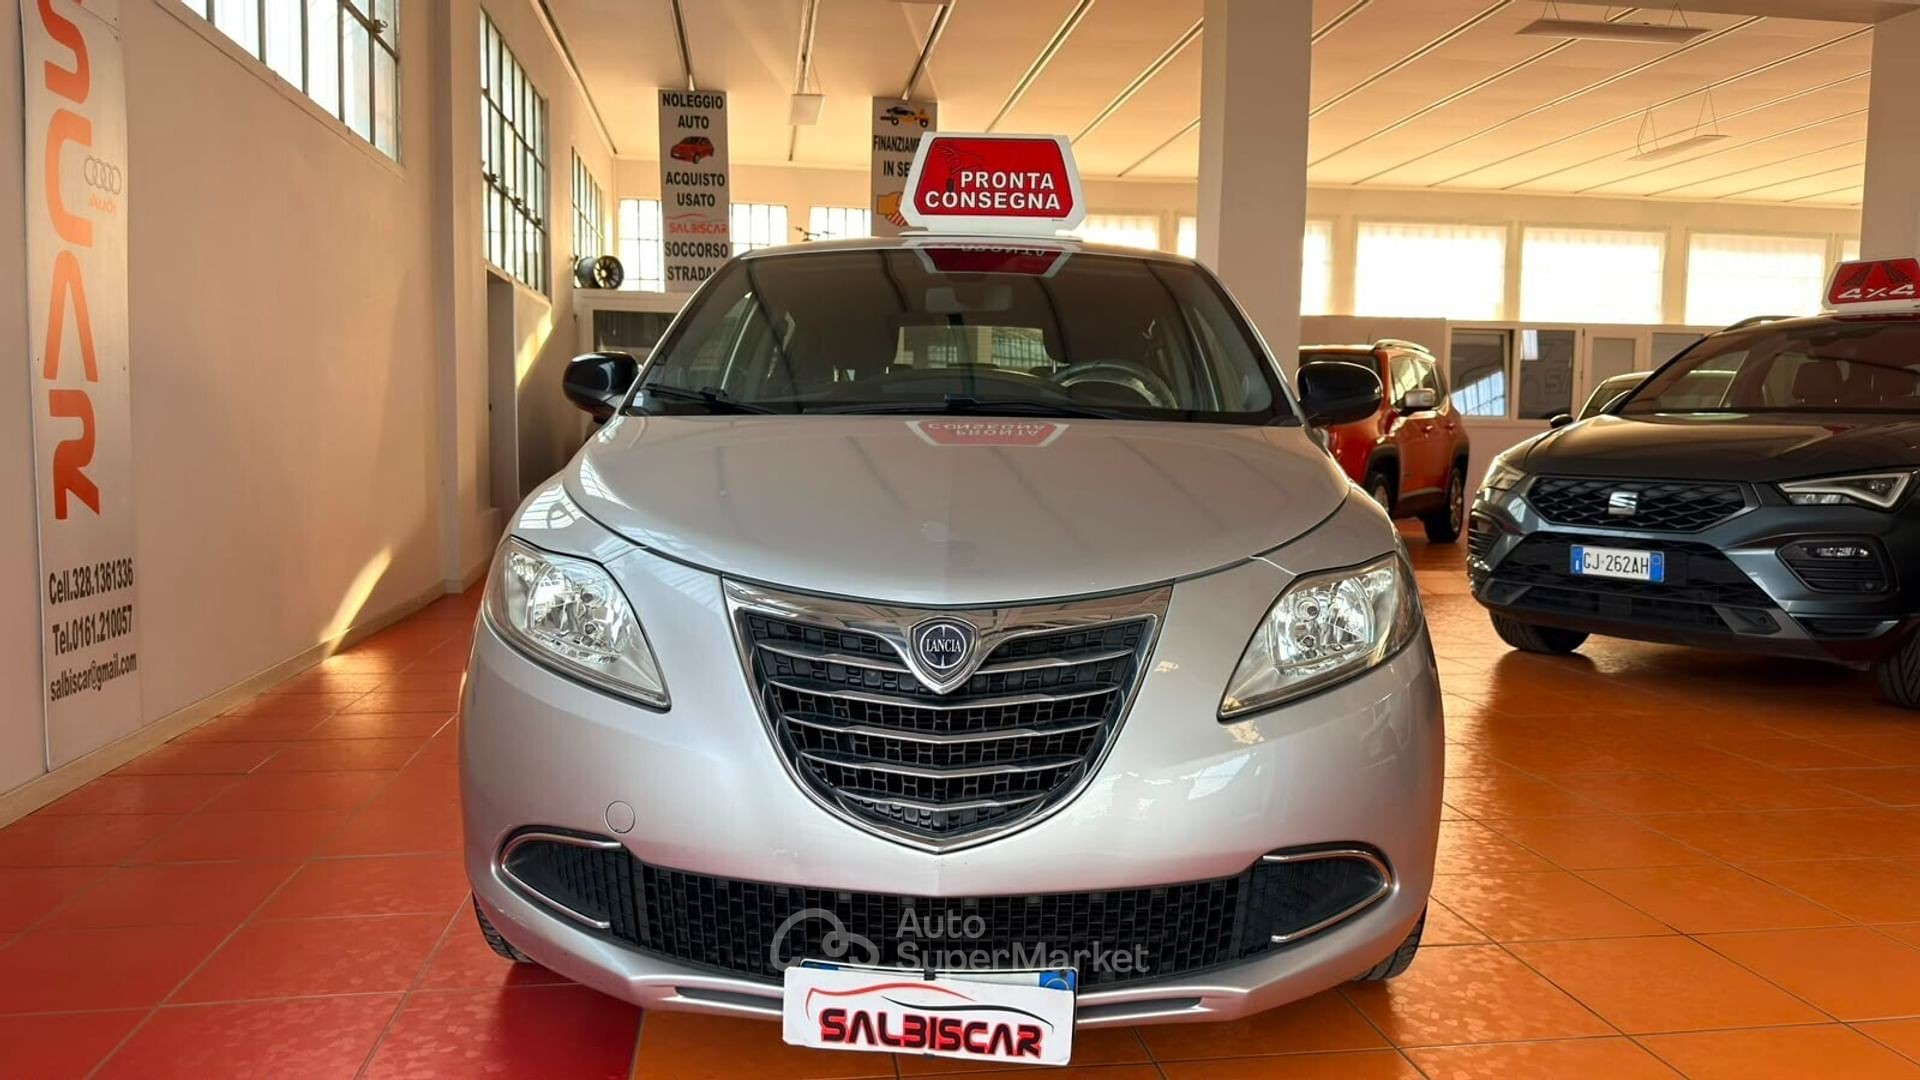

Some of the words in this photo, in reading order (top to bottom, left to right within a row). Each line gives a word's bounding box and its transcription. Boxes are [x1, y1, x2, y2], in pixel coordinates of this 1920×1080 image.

[662, 93, 724, 109] NOLEGGIO
[678, 115, 710, 129] AUTO
[883, 160, 894, 176] IN
[665, 172, 726, 187] ACQUISTO
[960, 171, 1054, 190] PRONTA
[676, 193, 716, 208] USATO
[925, 191, 1061, 210] CONSEGNA
[670, 222, 729, 234] SALBISCAR
[665, 241, 729, 258] SOCCORSO
[667, 266, 717, 281] STRADA
[49, 557, 134, 605] Cell.328.1361336
[52, 604, 132, 656] Tel.0161.210057
[926, 639, 961, 652] LANCIA
[50, 652, 137, 701] salbiscar@gmail.com
[819, 1007, 1043, 1059] SALBISCAR
